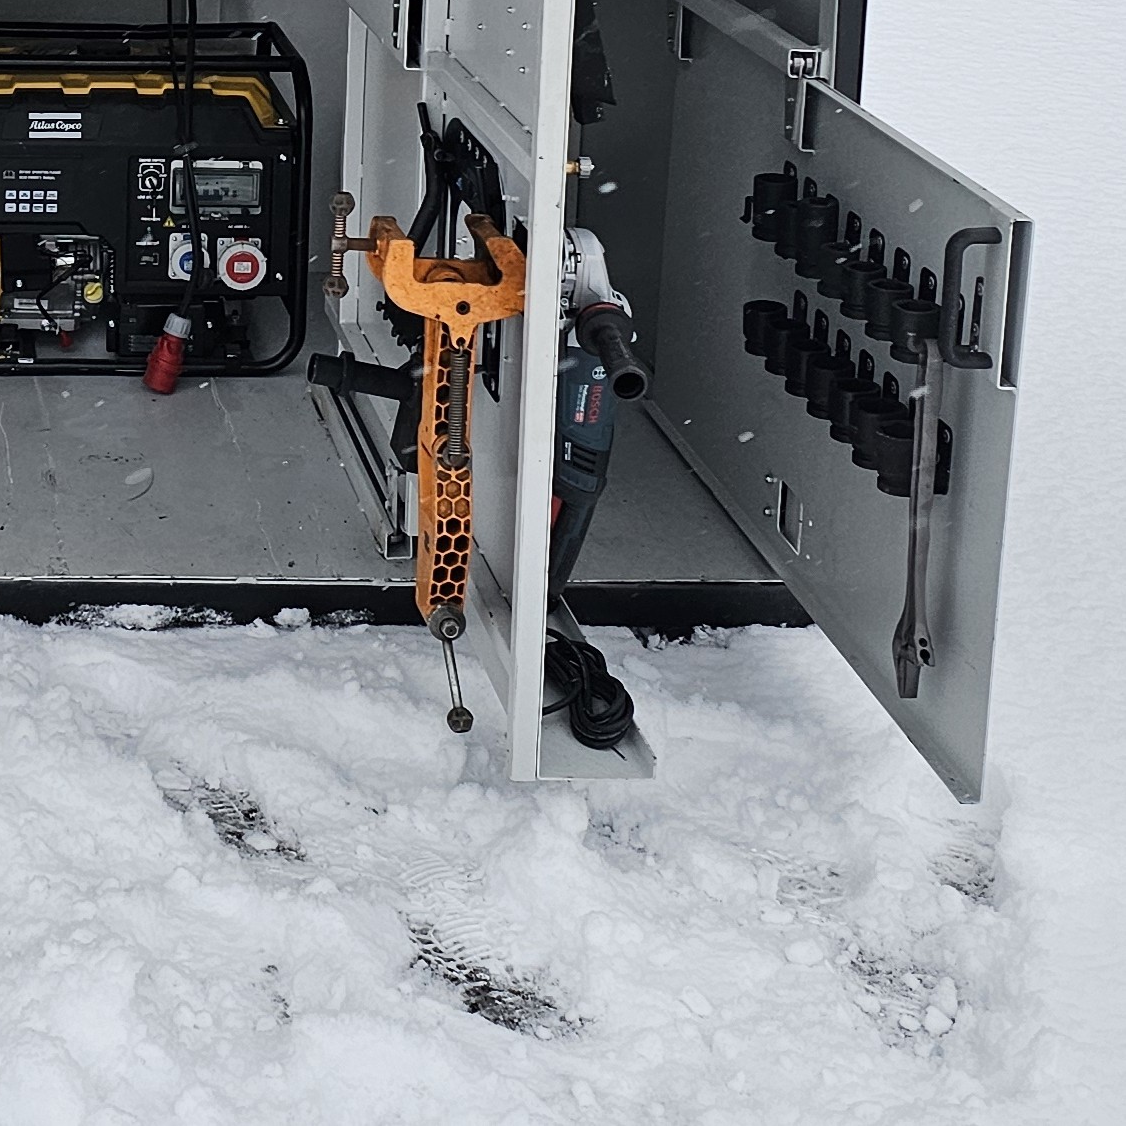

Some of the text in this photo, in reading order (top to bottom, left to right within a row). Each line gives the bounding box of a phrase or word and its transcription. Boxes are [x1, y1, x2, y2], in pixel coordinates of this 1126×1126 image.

[29, 120, 82, 131] Atlas Copco
[588, 385, 603, 424] BOSCH
